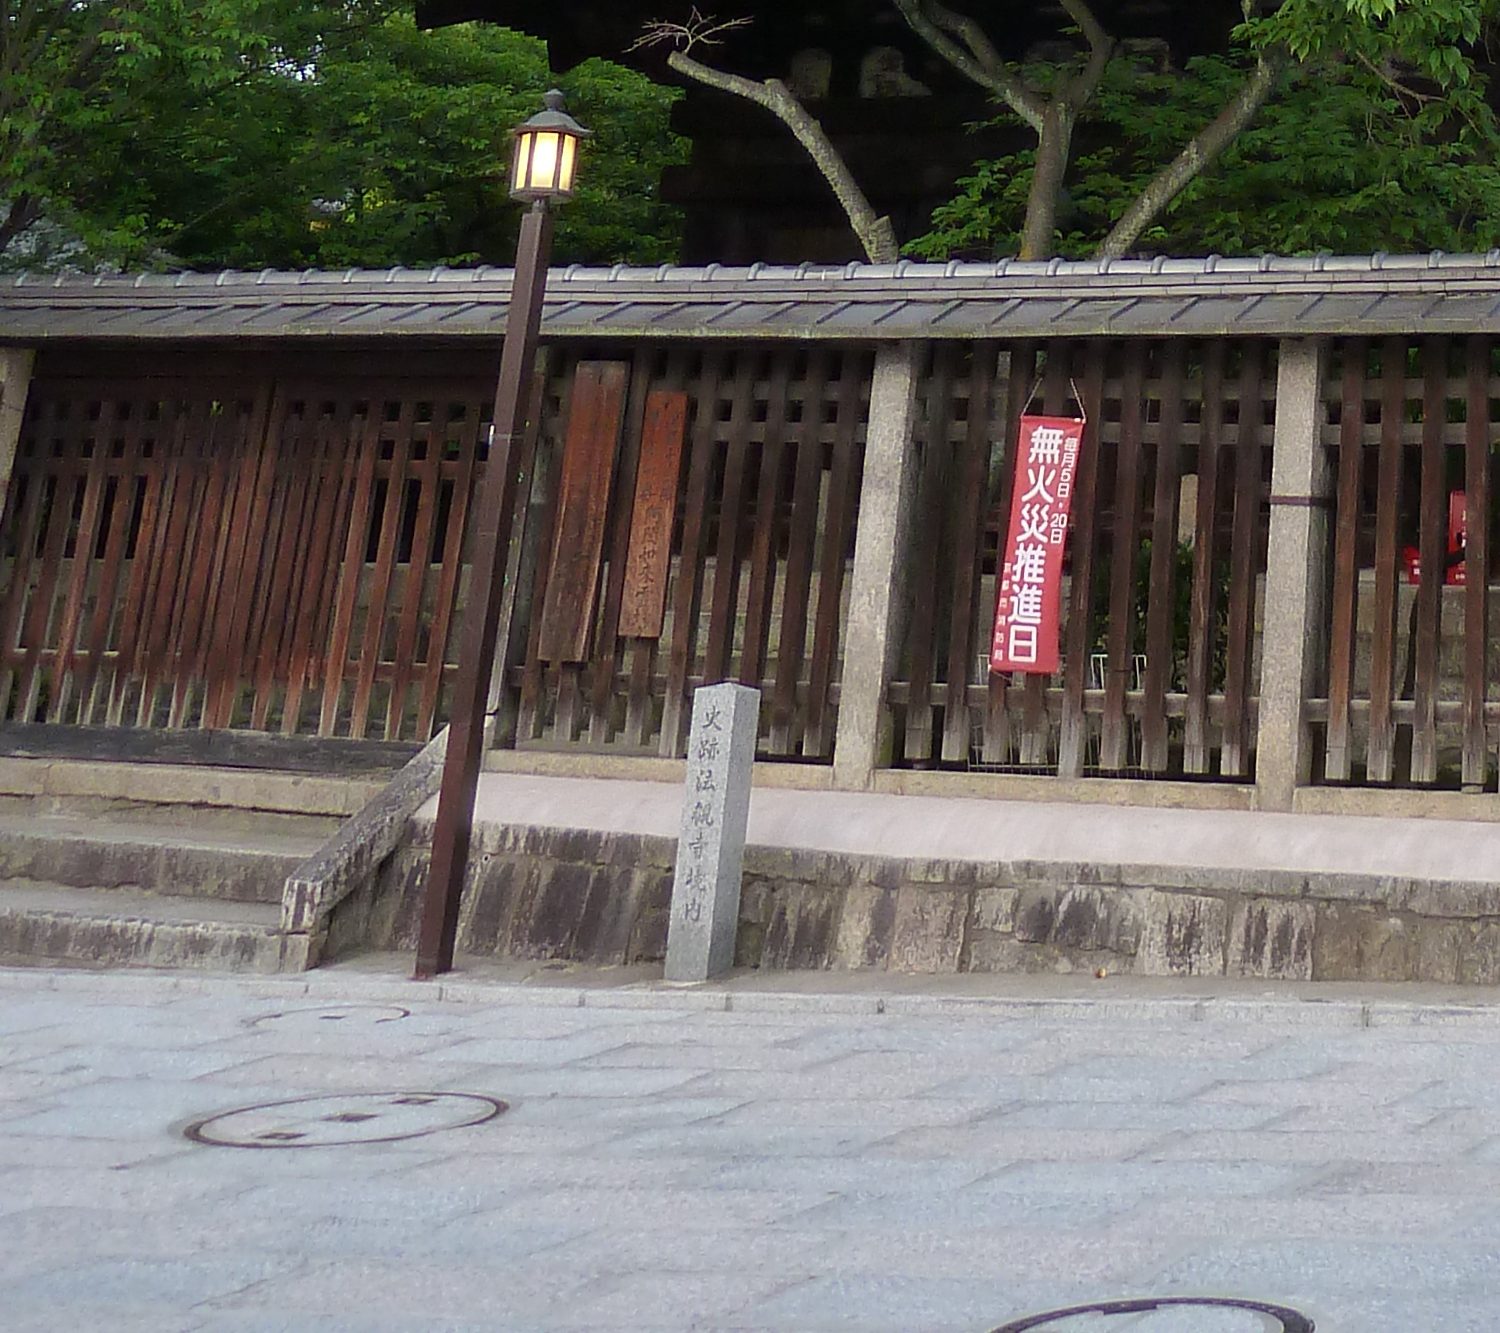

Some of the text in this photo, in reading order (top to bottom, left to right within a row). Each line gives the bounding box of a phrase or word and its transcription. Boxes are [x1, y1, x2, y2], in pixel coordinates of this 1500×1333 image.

[1007, 425, 1064, 664] 無火災推進日
